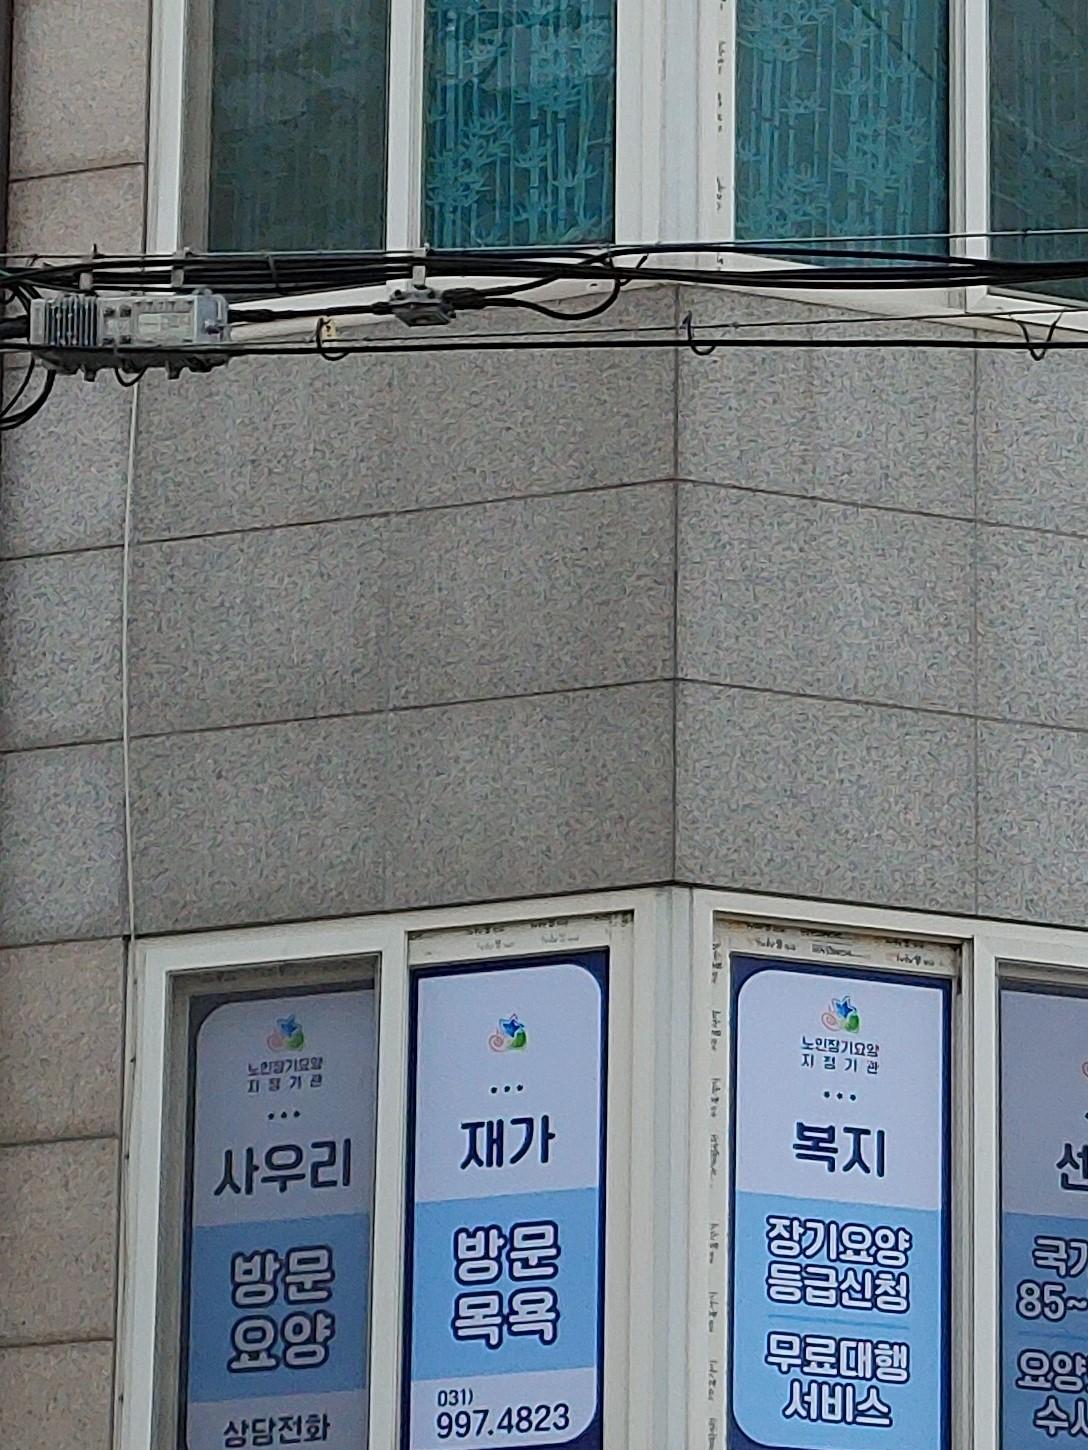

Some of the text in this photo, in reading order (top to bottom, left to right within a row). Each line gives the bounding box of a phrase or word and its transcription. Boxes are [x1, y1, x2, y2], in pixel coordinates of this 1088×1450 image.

[247, 1056, 323, 1076] 노인장기요양
[801, 1035, 880, 1057] 노인장기요양
[213, 1138, 352, 1197] 사우리
[459, 1114, 556, 1170] 재가
[792, 1121, 886, 1178] 복지
[453, 1219, 561, 1285] 방문
[766, 1214, 912, 1269] 장기요양
[229, 1244, 336, 1309] 방문
[766, 1260, 911, 1315] 등급신청
[227, 1309, 336, 1373] 요양
[451, 1286, 561, 1349] 목욕
[766, 1331, 910, 1384] 무료대행
[435, 1402, 570, 1440] 997.4823
[436, 1389, 474, 1407] 031)
[782, 1384, 894, 1428] 서비스
[222, 1413, 331, 1450] 상담전화
